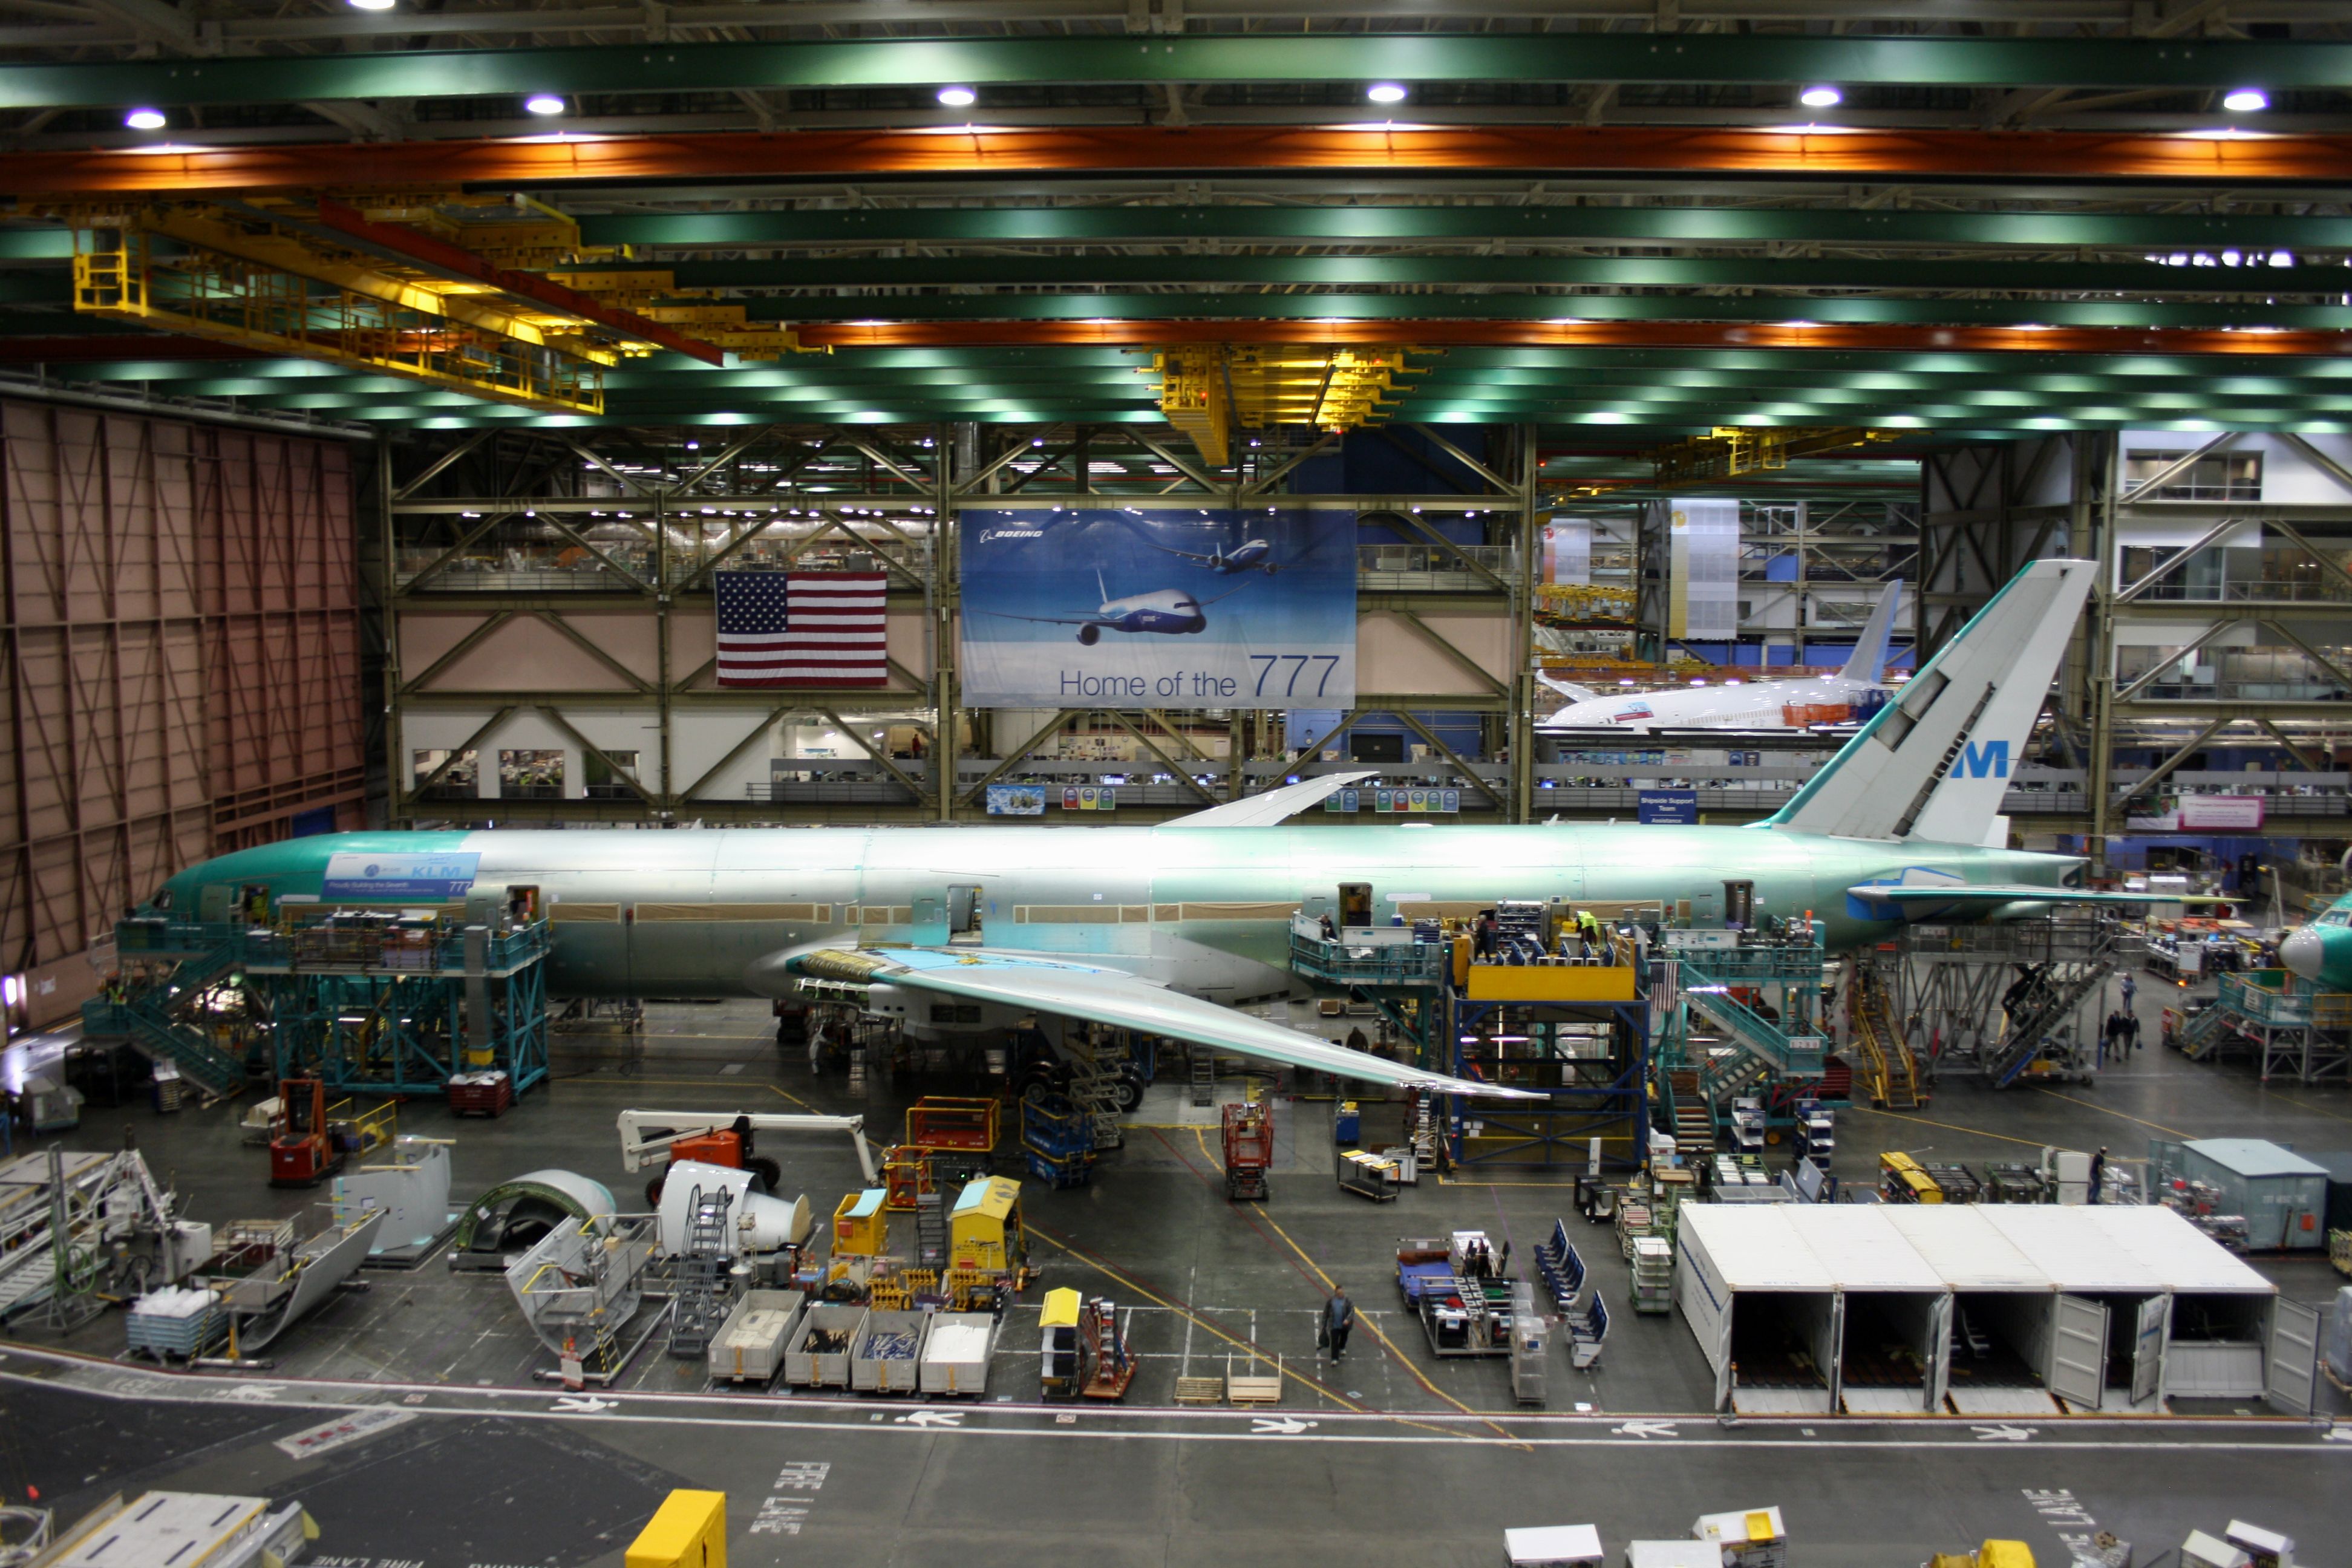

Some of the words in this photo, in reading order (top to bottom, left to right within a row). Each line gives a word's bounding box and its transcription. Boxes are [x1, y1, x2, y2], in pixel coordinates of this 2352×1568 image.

[1060, 670, 1146, 696] Home
[1155, 671, 1183, 697] of
[1192, 671, 1236, 697] the
[1250, 655, 1340, 697] 777
[412, 866, 461, 878] KLM
[449, 881, 472, 892] 777
[774, 1461, 832, 1490] FIRE
[749, 1496, 815, 1535] LANE
[2021, 1489, 2097, 1525] LANE
[310, 1555, 371, 1568] LANE
